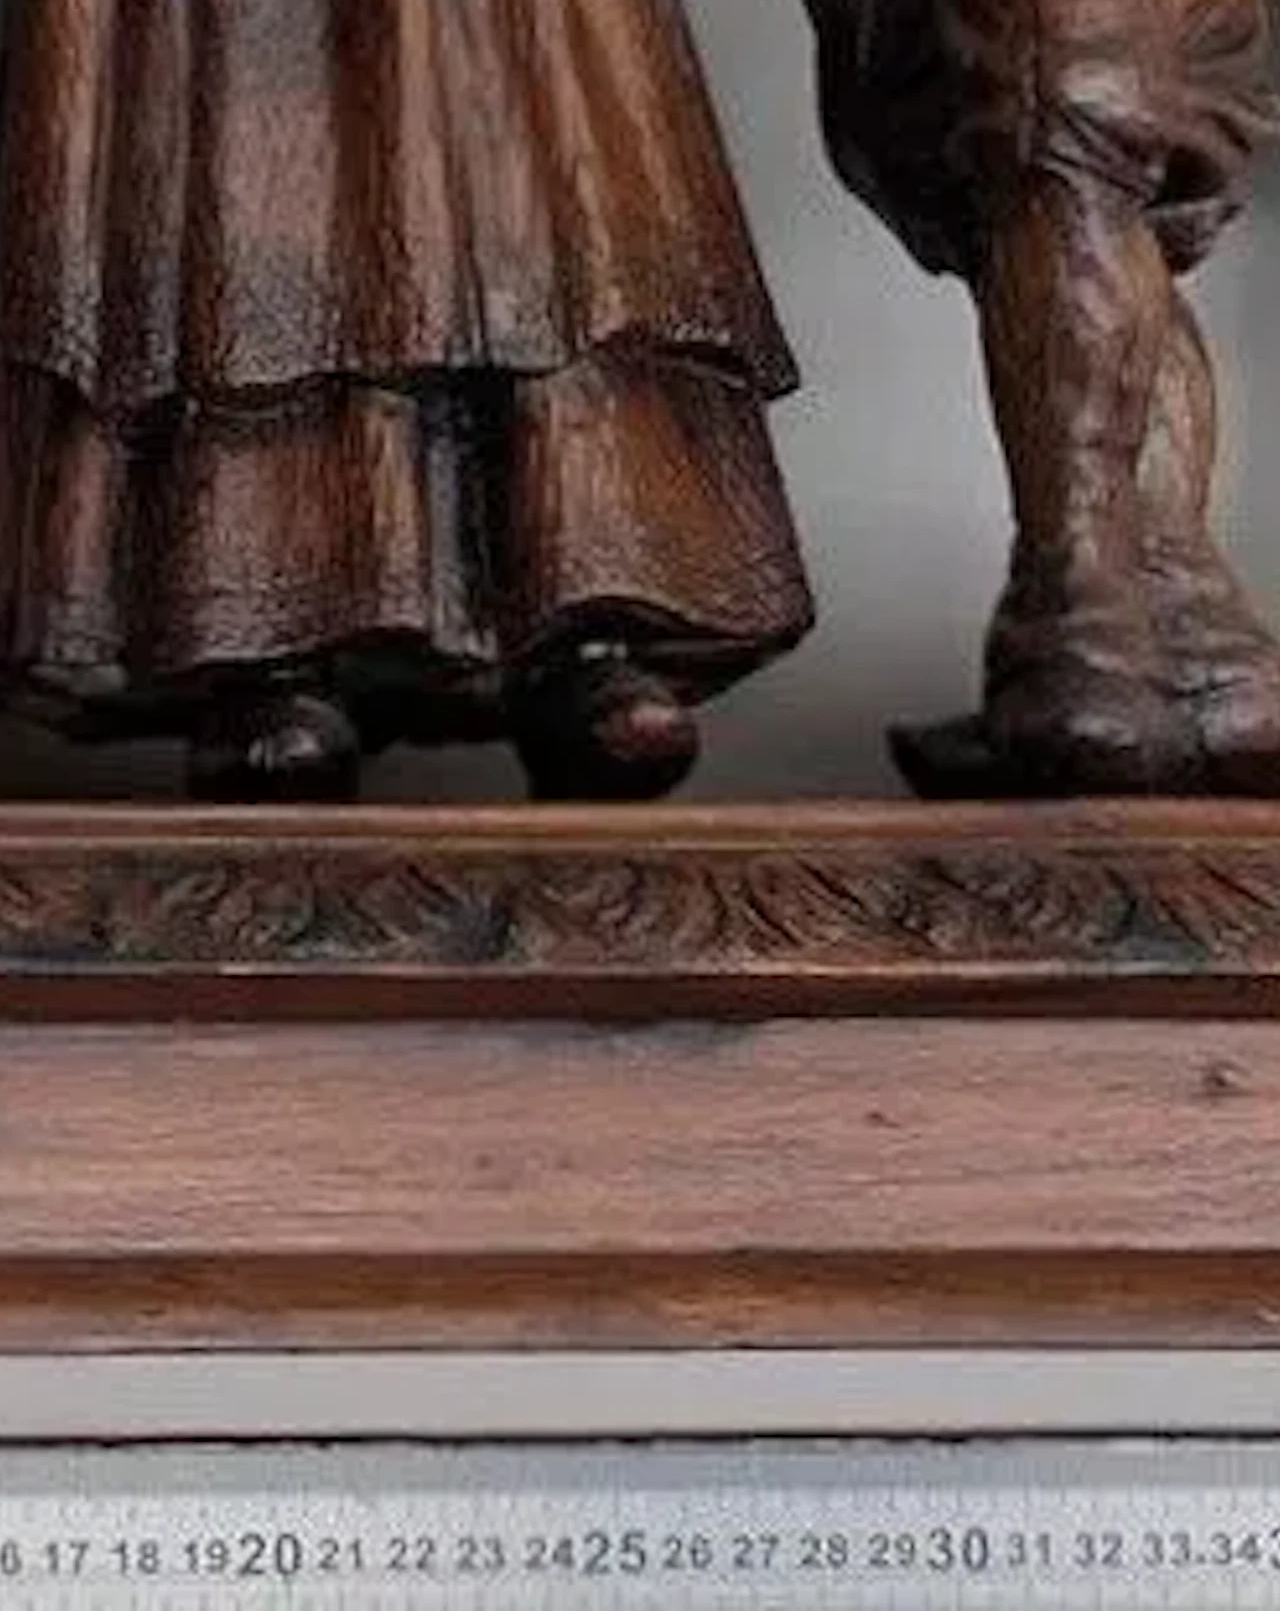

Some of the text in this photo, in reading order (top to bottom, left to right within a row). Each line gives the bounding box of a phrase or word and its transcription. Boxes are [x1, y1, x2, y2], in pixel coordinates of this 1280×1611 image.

[46, 1541, 90, 1576] 17
[112, 1540, 160, 1575] 18
[184, 1539, 230, 1574] 19
[237, 1532, 303, 1583] 20
[318, 1538, 363, 1572] 21
[387, 1537, 436, 1573] 22
[457, 1537, 506, 1572] 23
[525, 1538, 575, 1570] 24
[583, 1531, 647, 1576] 25
[663, 1535, 713, 1570] 26
[733, 1535, 779, 1569] 27
[800, 1536, 848, 1570] 28
[869, 1534, 916, 1568] 29
[927, 1526, 990, 1573] 30
[1008, 1533, 1050, 1567] 31
[1076, 1534, 1123, 1568] 32
[1145, 1533, 1191, 1563] 33
[1214, 1532, 1261, 1566] 34
